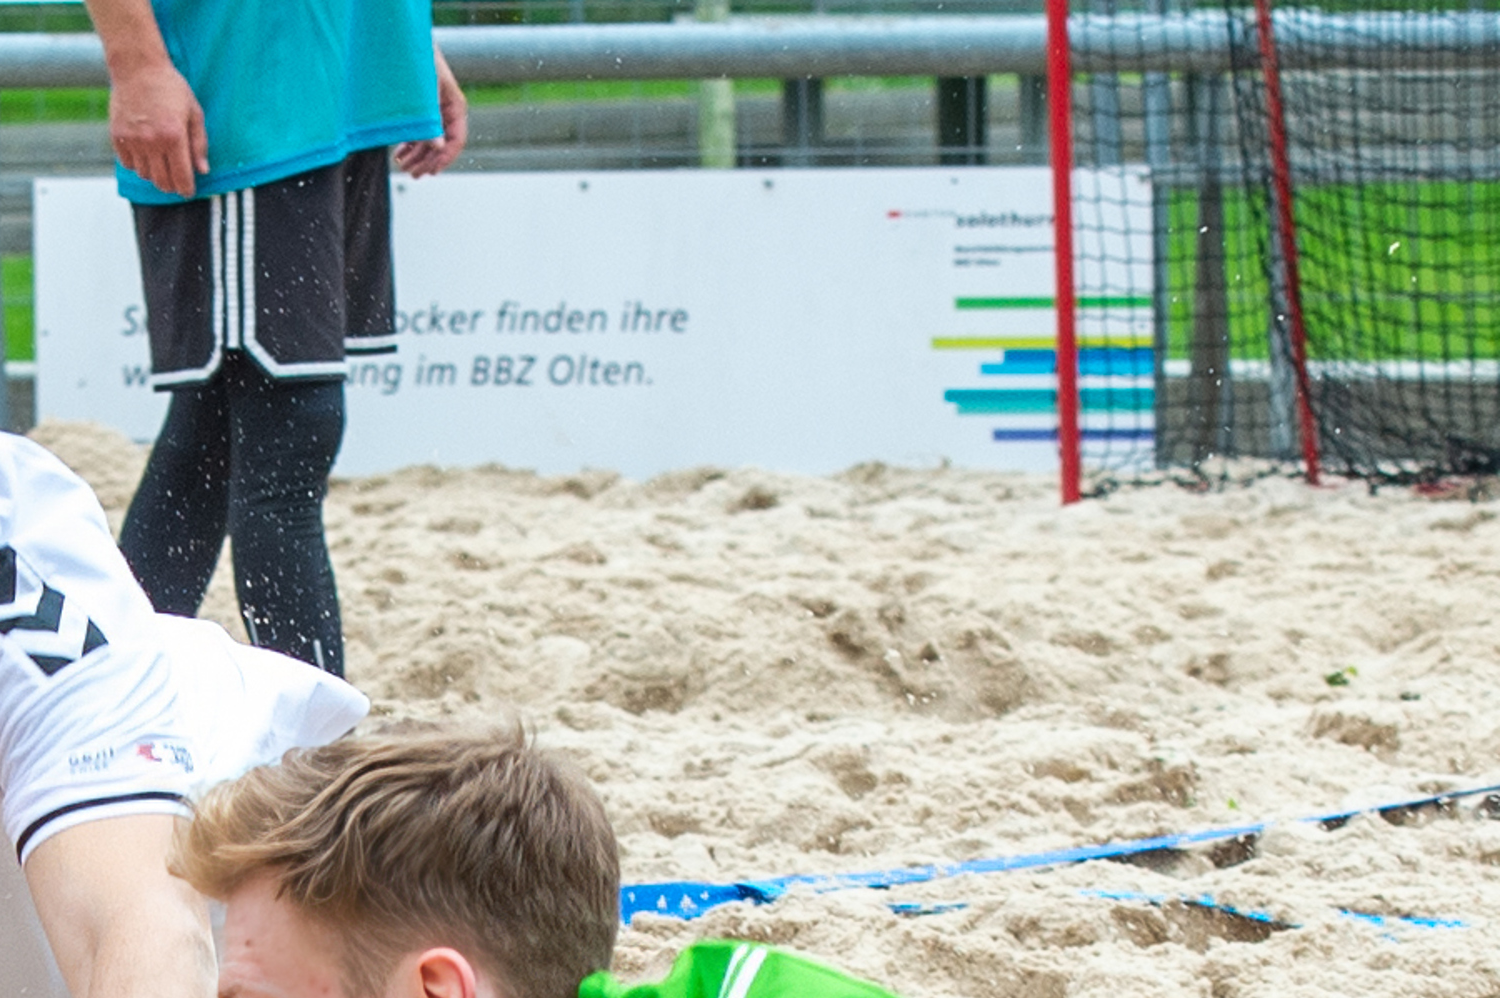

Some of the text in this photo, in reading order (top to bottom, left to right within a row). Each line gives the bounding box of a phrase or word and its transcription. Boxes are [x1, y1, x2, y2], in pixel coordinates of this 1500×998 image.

[495, 301, 607, 334] finden
[619, 301, 689, 334] ihre
[415, 355, 457, 386] im
[470, 355, 537, 386] BBZ
[548, 354, 653, 386] Olten.
